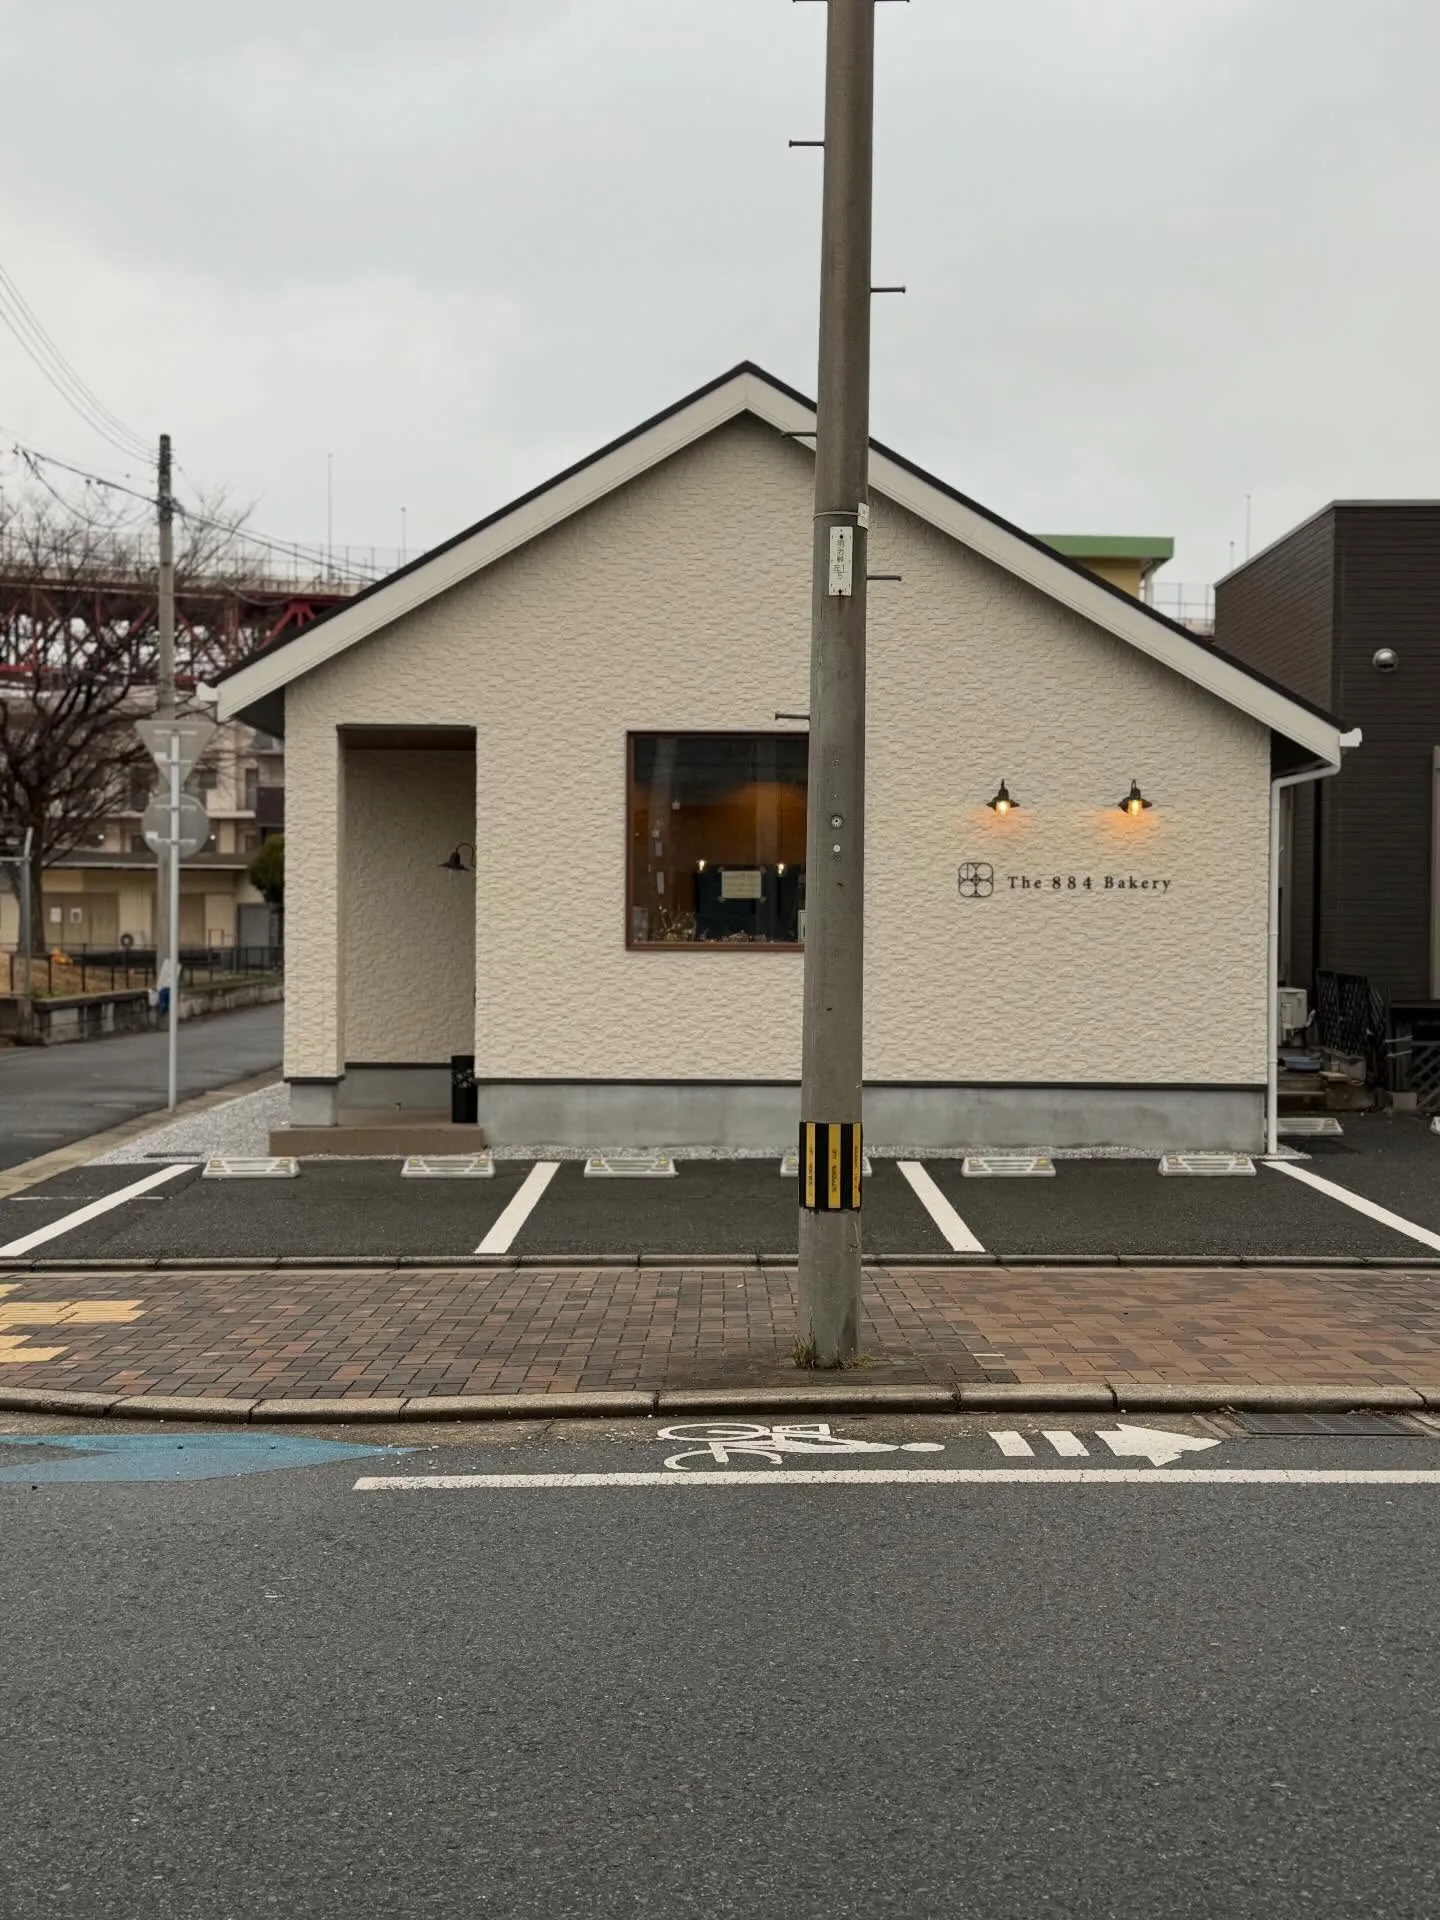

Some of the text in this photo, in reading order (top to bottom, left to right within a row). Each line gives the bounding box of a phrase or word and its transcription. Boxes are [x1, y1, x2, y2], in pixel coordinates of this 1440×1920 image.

[1007, 876, 1172, 893] The 884 Bakery
